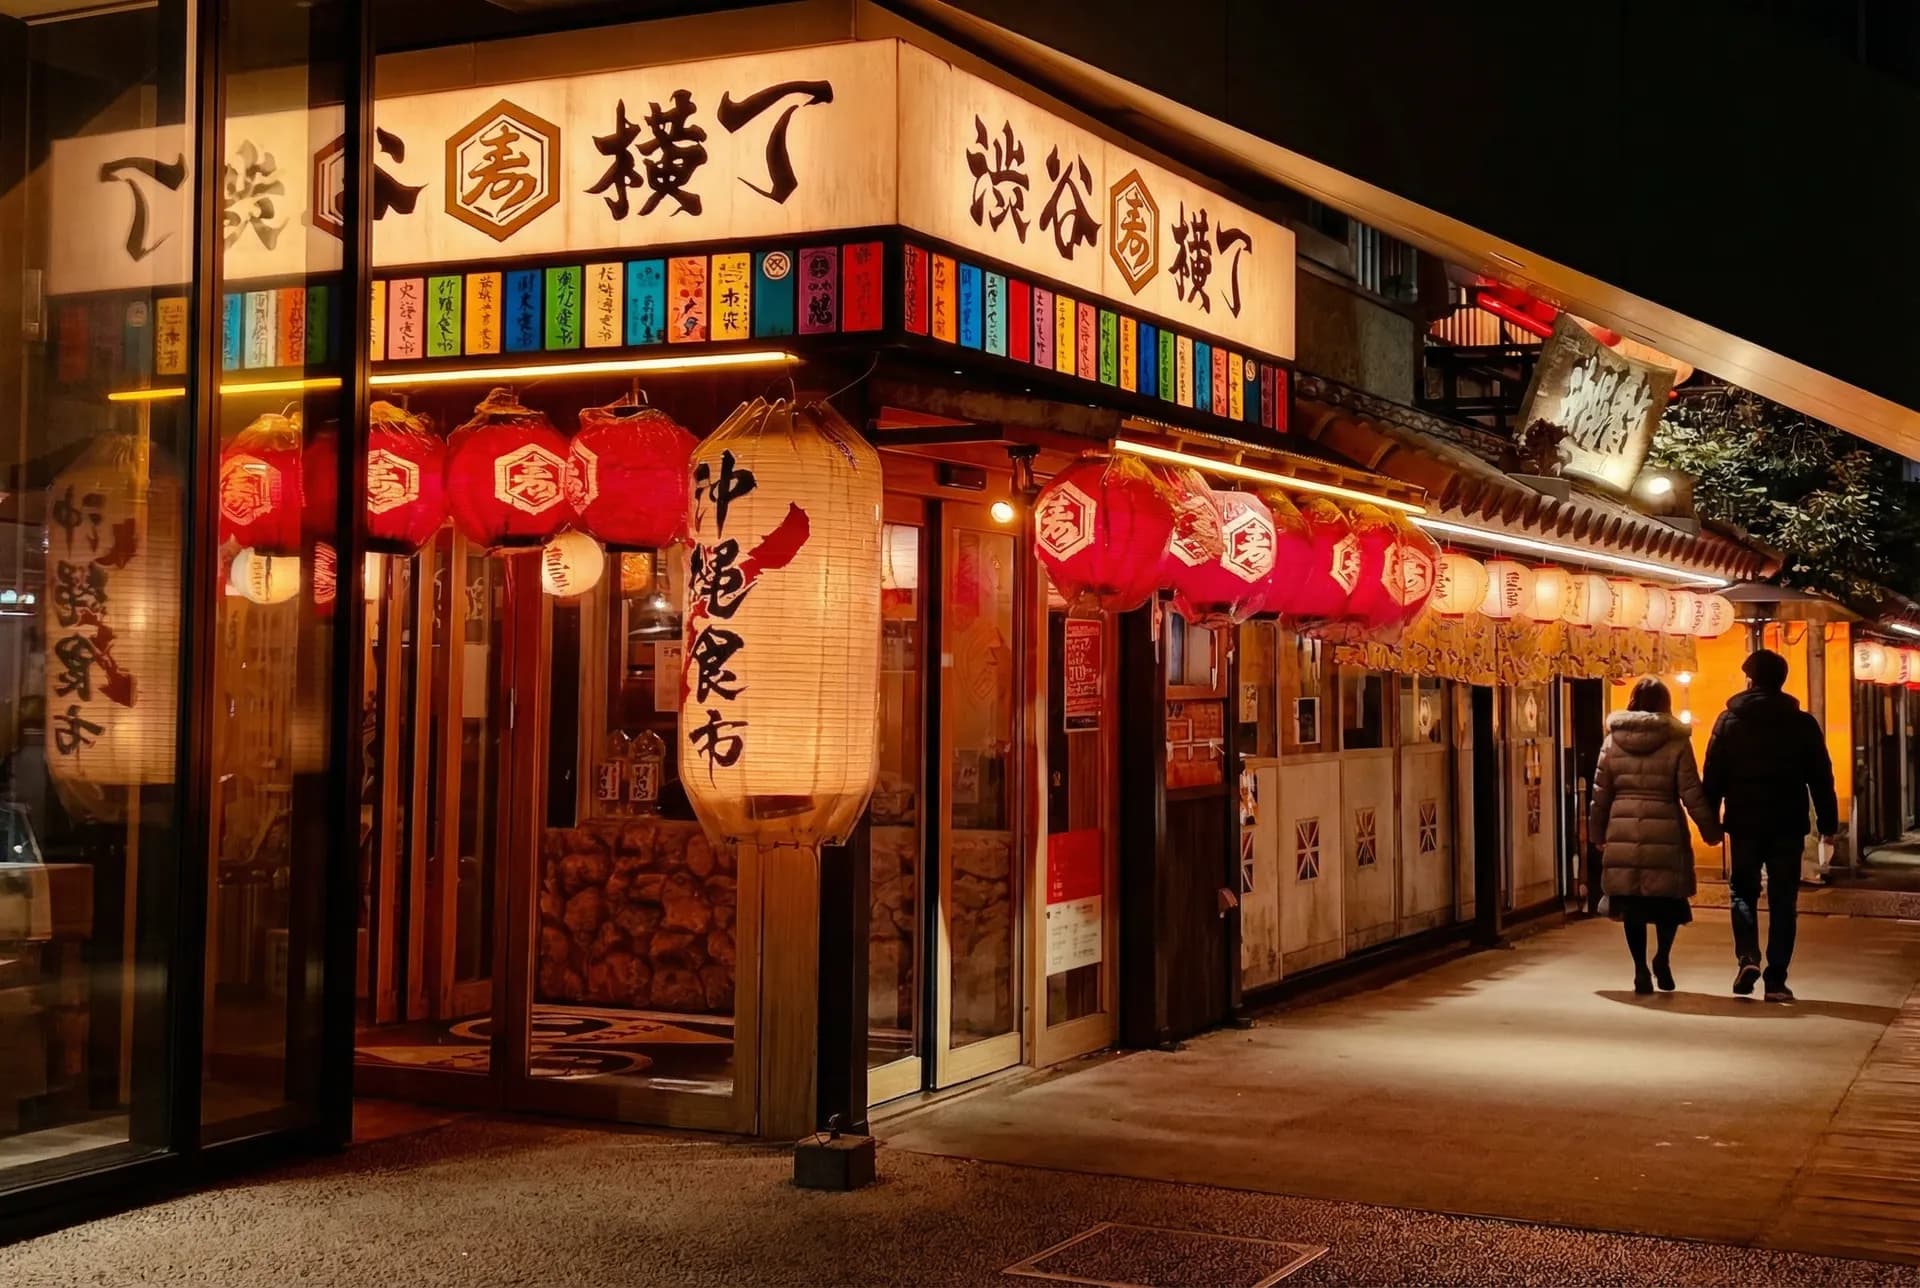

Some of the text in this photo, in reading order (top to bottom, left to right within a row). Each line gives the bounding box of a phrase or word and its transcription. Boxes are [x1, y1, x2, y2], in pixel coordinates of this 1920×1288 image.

[583, 80, 834, 221] 横丁
[966, 114, 1102, 260] 渋谷
[1168, 200, 1253, 319] 横丁
[689, 449, 758, 790] 沖縄食市
